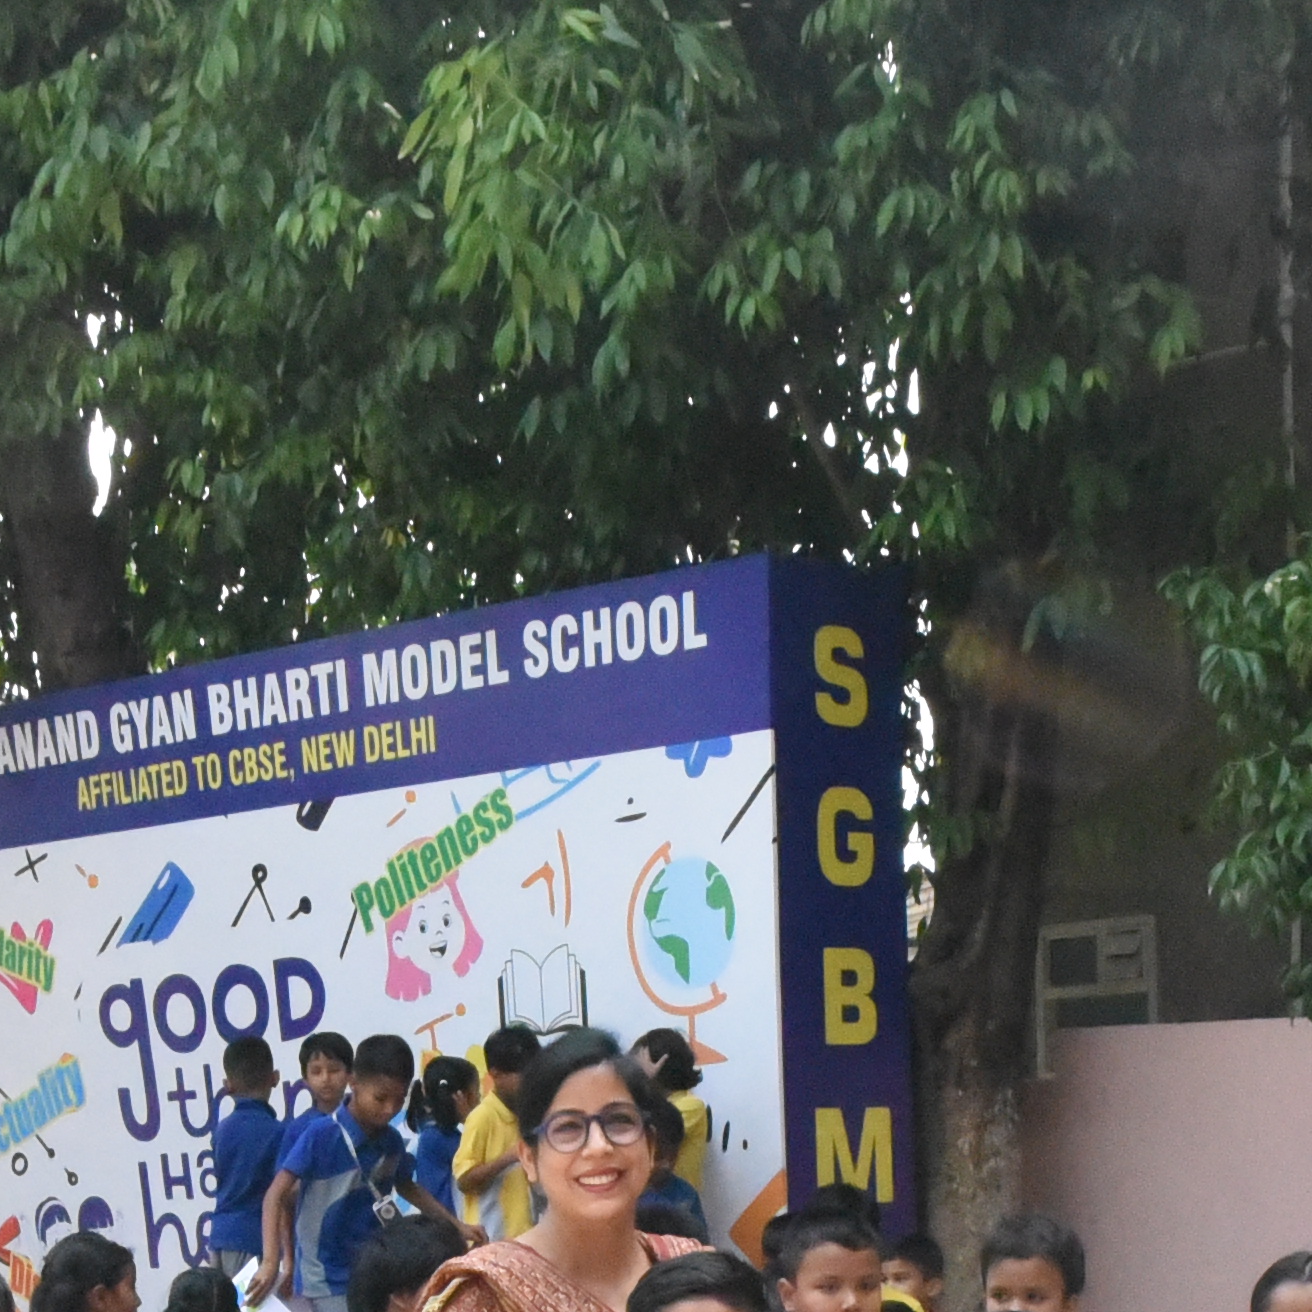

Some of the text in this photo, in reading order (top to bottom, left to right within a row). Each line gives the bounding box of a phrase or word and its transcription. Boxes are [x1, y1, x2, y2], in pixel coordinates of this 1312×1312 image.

[109, 689, 196, 754] GYAN
[207, 659, 349, 736] BHARTI
[362, 629, 509, 707] MODEL
[523, 591, 708, 679] SCHOOL
[77, 715, 436, 812] AFFILIATED TO CBSE, NEW DELHI
[353, 787, 515, 934] Politeness
